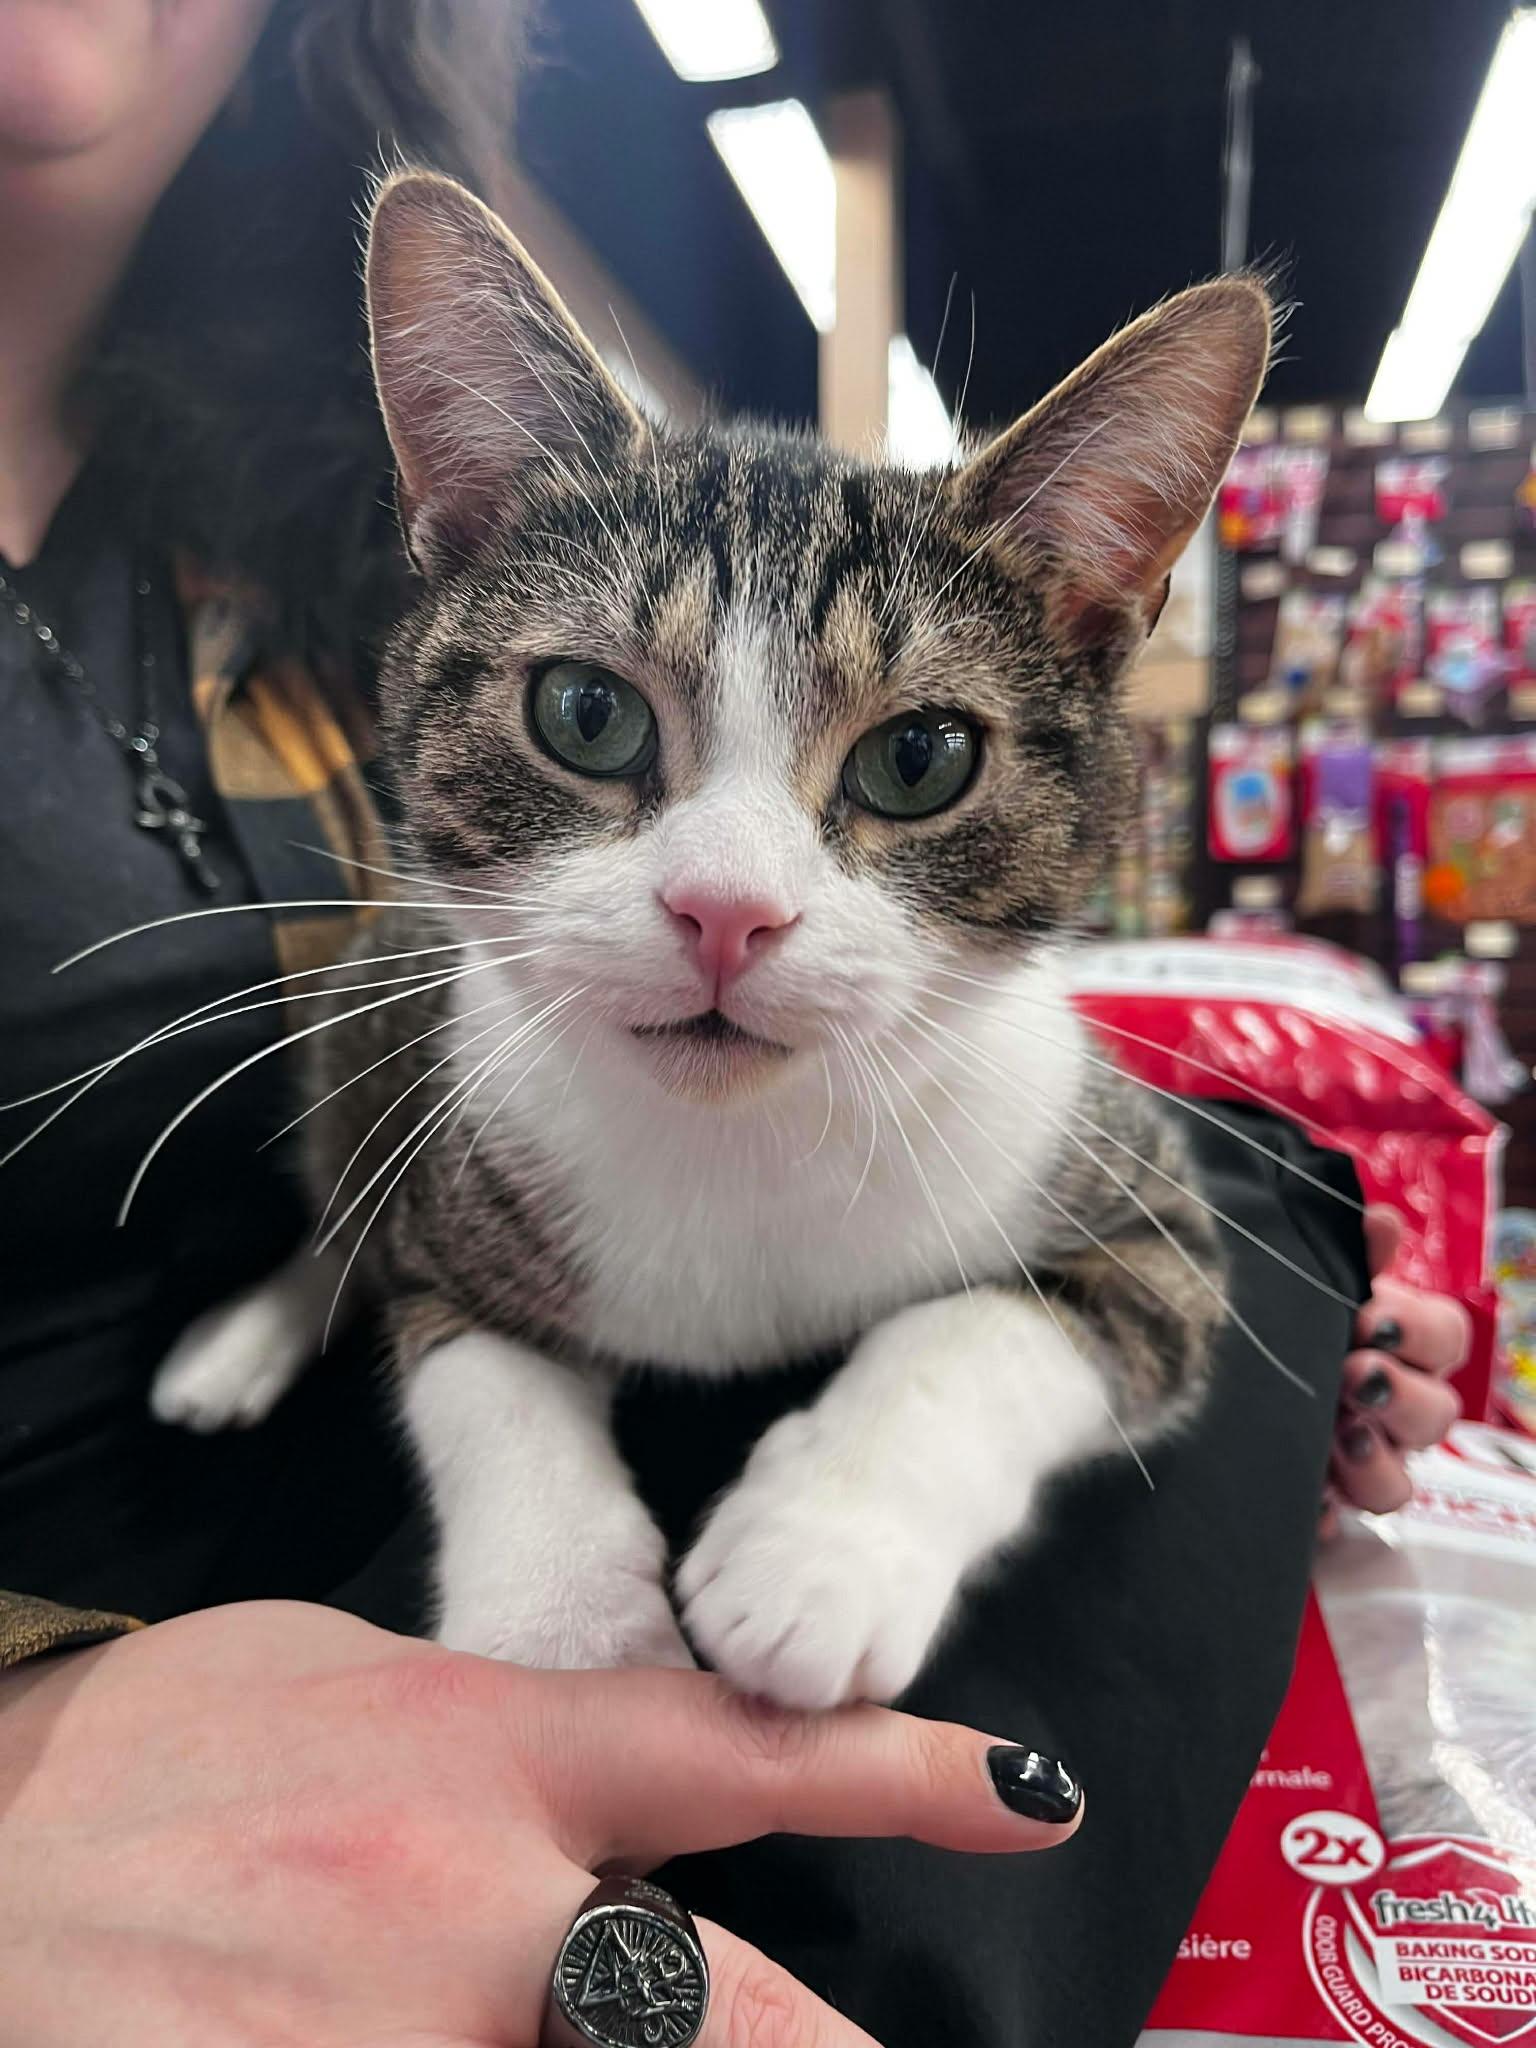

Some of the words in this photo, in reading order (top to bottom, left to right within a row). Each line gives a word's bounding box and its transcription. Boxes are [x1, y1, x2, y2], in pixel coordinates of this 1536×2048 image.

[1315, 1915, 1338, 1964] ODOR
[1397, 1943, 1485, 1960] BAKING
[1322, 1965, 1372, 2026] GUARD
[1425, 1984, 1458, 2001] DE
[1463, 1986, 1536, 2005] SOUD
